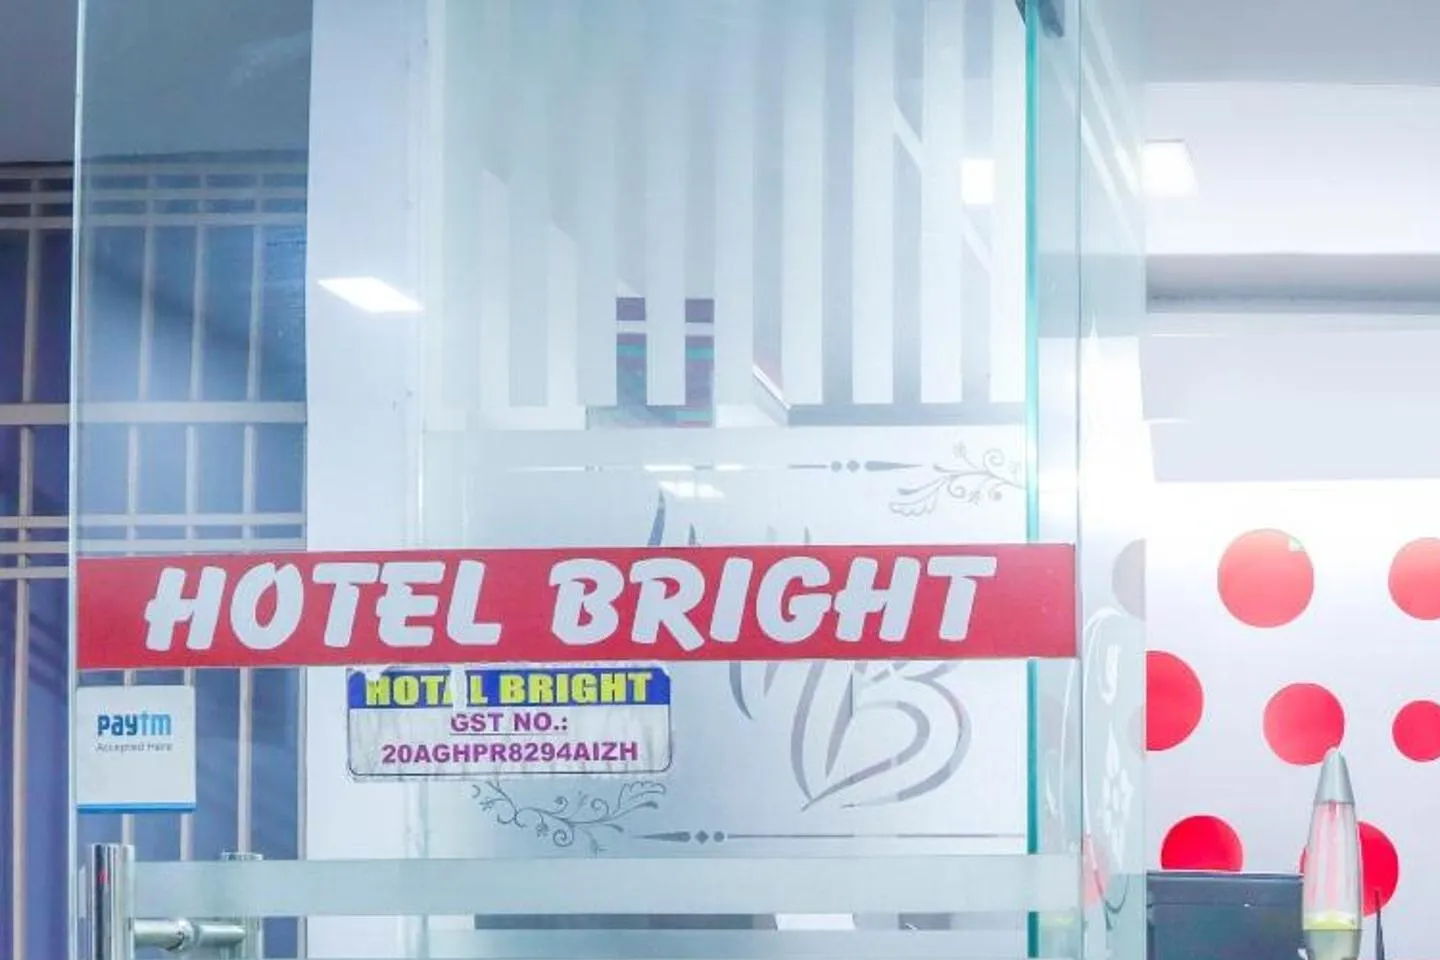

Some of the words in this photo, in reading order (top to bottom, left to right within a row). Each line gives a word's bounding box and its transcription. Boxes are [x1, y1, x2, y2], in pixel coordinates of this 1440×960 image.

[144, 560, 503, 652] HOTEL
[549, 555, 998, 652] BRIGHT
[366, 675, 488, 706] HOTL
[500, 672, 652, 704] BRIGHT
[451, 713, 504, 732] GST
[514, 711, 568, 732] NO.:
